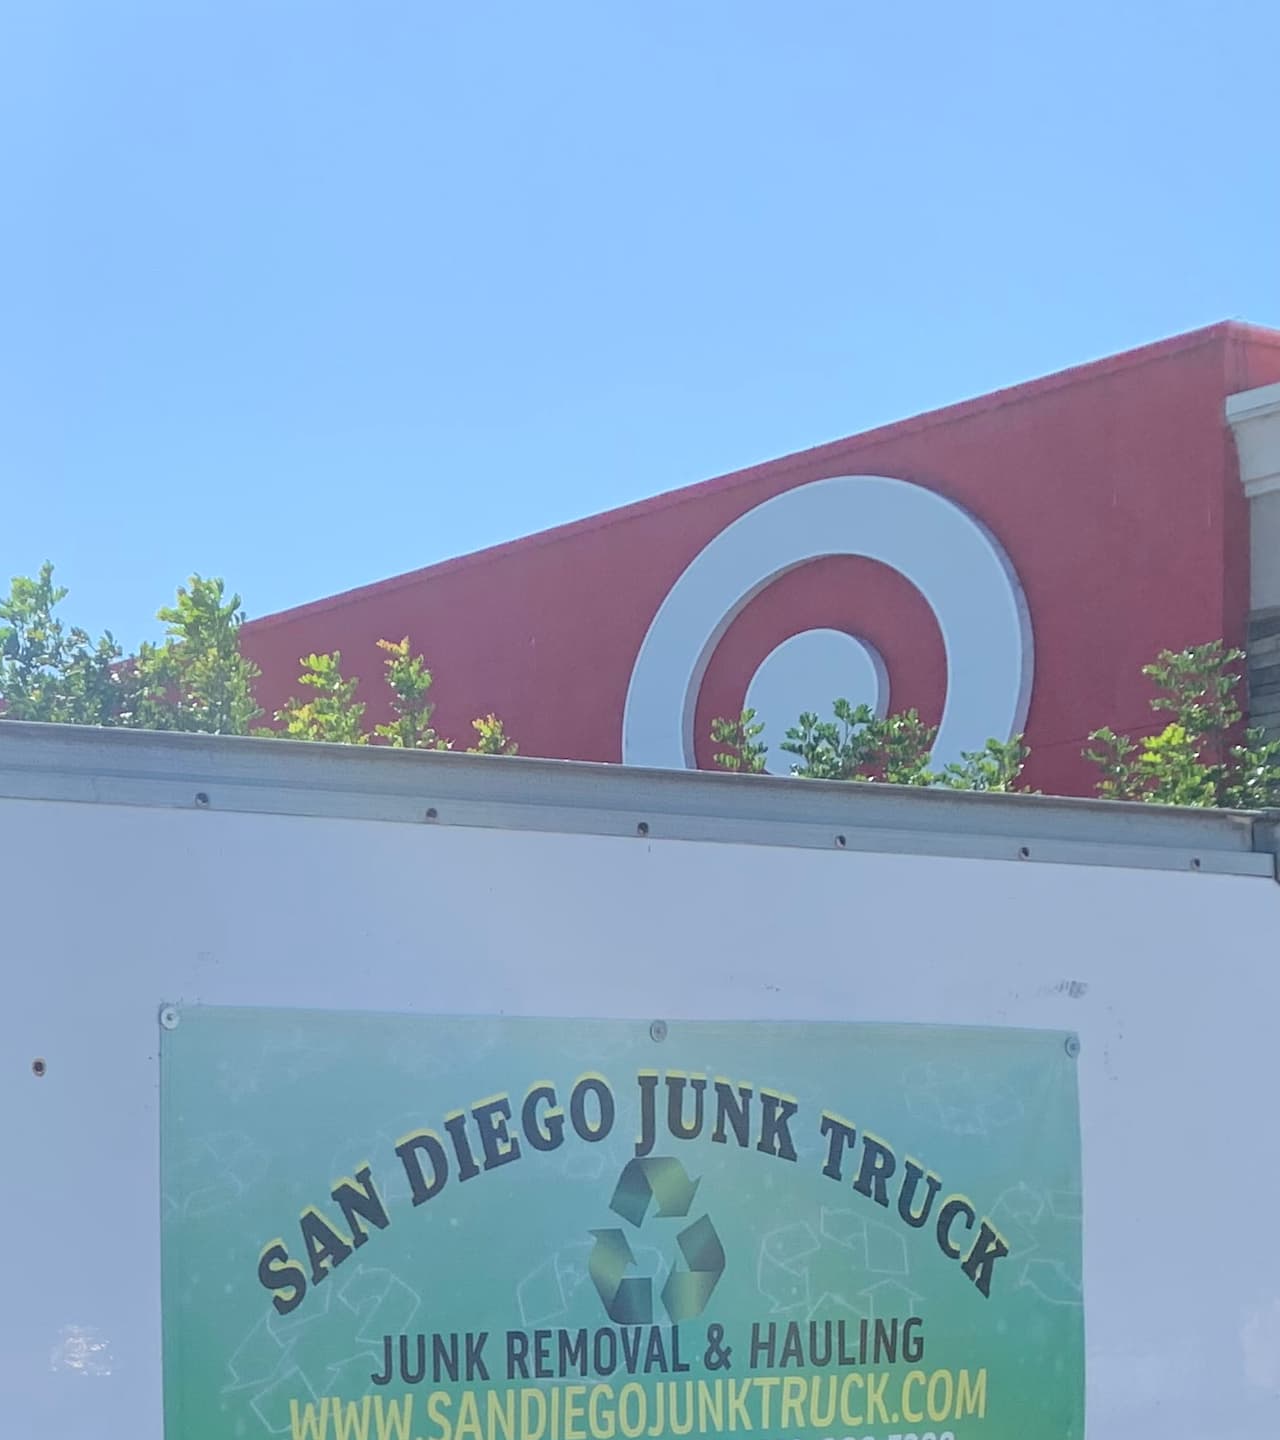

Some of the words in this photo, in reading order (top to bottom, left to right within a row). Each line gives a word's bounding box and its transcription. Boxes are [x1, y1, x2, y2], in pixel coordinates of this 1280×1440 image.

[257, 1160, 390, 1316] SAN
[394, 1072, 616, 1207] DIEGO
[635, 1069, 799, 1162] JUNK
[819, 1109, 1010, 1300] TRUCK
[370, 1331, 490, 1386] JUNK
[505, 1324, 691, 1381] REMOVAL
[703, 1322, 733, 1372] &
[749, 1316, 925, 1370] HAULING
